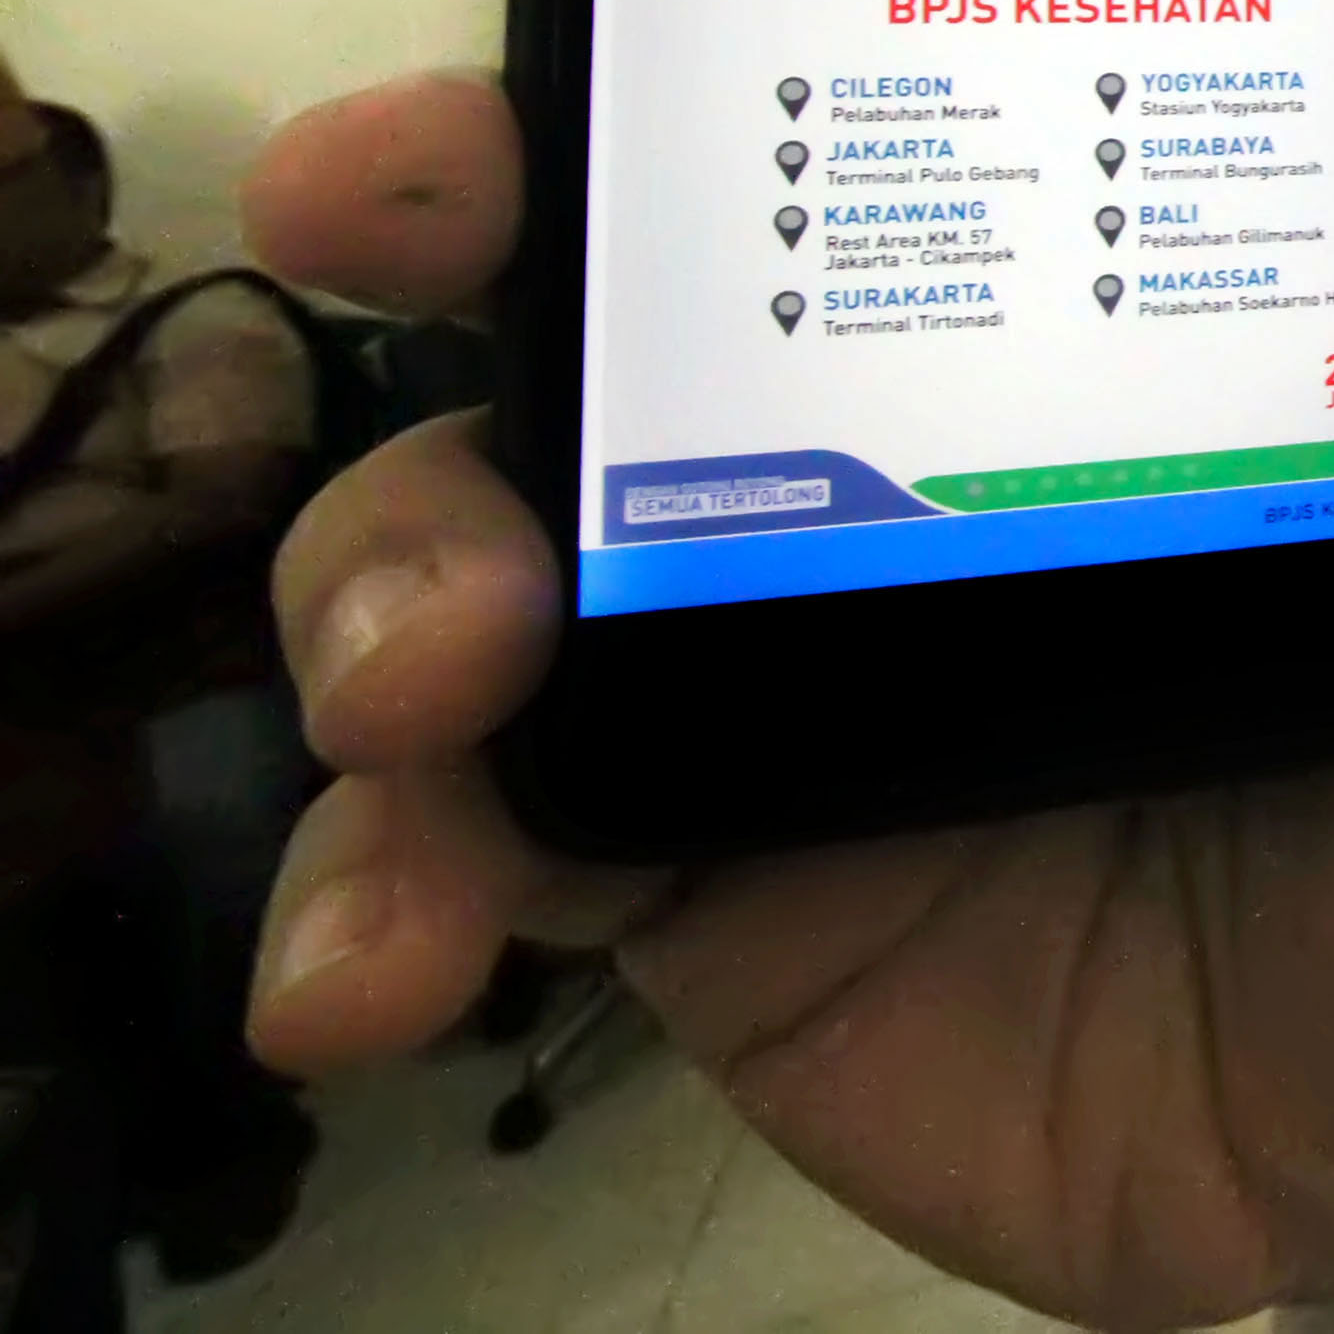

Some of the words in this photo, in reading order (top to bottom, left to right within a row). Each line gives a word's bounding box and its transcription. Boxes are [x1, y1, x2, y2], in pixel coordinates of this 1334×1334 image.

[831, 77, 952, 99] CILEGON
[1141, 71, 1305, 93] YOGYAKARTA
[830, 107, 935, 123] Pelabuhan
[941, 105, 1001, 121] Merak
[1140, 101, 1206, 116] Stasiun
[1211, 99, 1306, 118] Yogyakarta
[826, 138, 955, 162] JAKARTA
[1140, 136, 1275, 158] SURABAYA
[826, 169, 913, 186] Terminal
[919, 167, 963, 183] Pulo
[968, 165, 1040, 183] Gebang
[1140, 164, 1219, 181] Terminal
[1224, 162, 1323, 180] Bungurasih
[824, 201, 987, 226] KARAWANG
[1139, 204, 1198, 225] BALI
[826, 235, 870, 251] Rest
[876, 233, 921, 250] Area
[928, 231, 965, 246] KM.
[970, 229, 993, 245] 57
[1139, 231, 1233, 249] Pelabuhan
[824, 254, 900, 271] Jakarta
[919, 248, 1015, 266] Cikampek
[1139, 267, 1279, 293] MAKASSAR
[823, 282, 995, 311] SURAKARTA
[1139, 298, 1233, 317] Pelabuhan
[1239, 293, 1321, 312] Soekarno
[824, 316, 912, 336] Terminal
[919, 311, 1005, 331] Tirtonadi
[631, 496, 703, 517] SEMUA
[709, 485, 825, 510] TERTOLONG
[1264, 504, 1315, 524] BPJS
